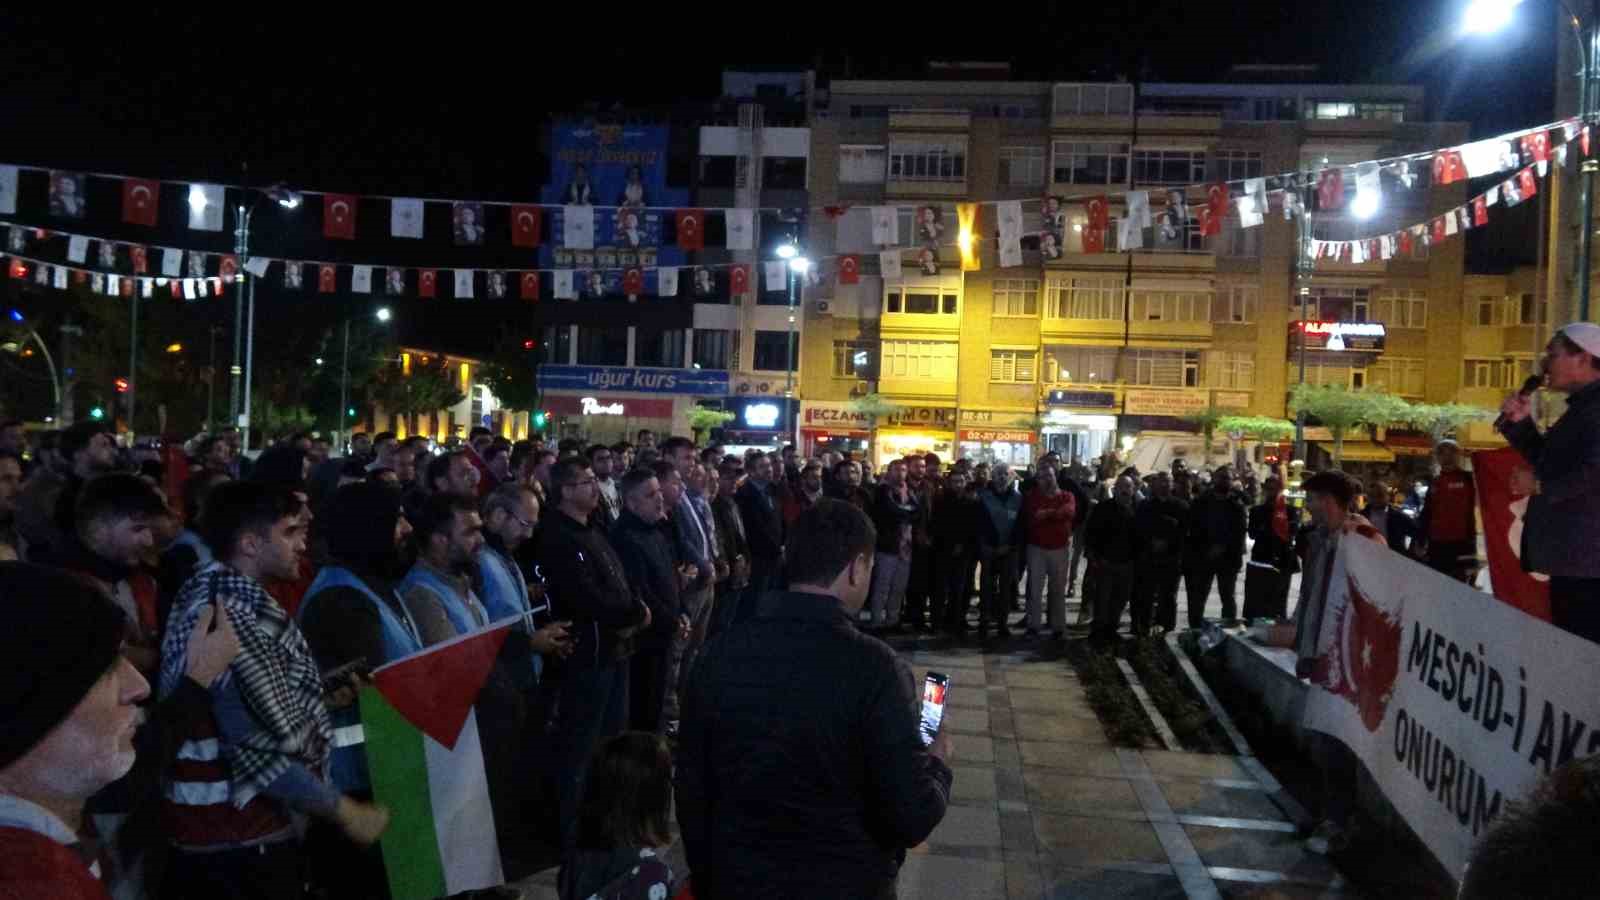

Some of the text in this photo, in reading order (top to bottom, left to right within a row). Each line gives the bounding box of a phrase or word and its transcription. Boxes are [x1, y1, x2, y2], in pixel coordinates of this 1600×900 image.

[588, 369, 677, 389] uğur kurs
[1407, 621, 1527, 753] MESCİD-İ
